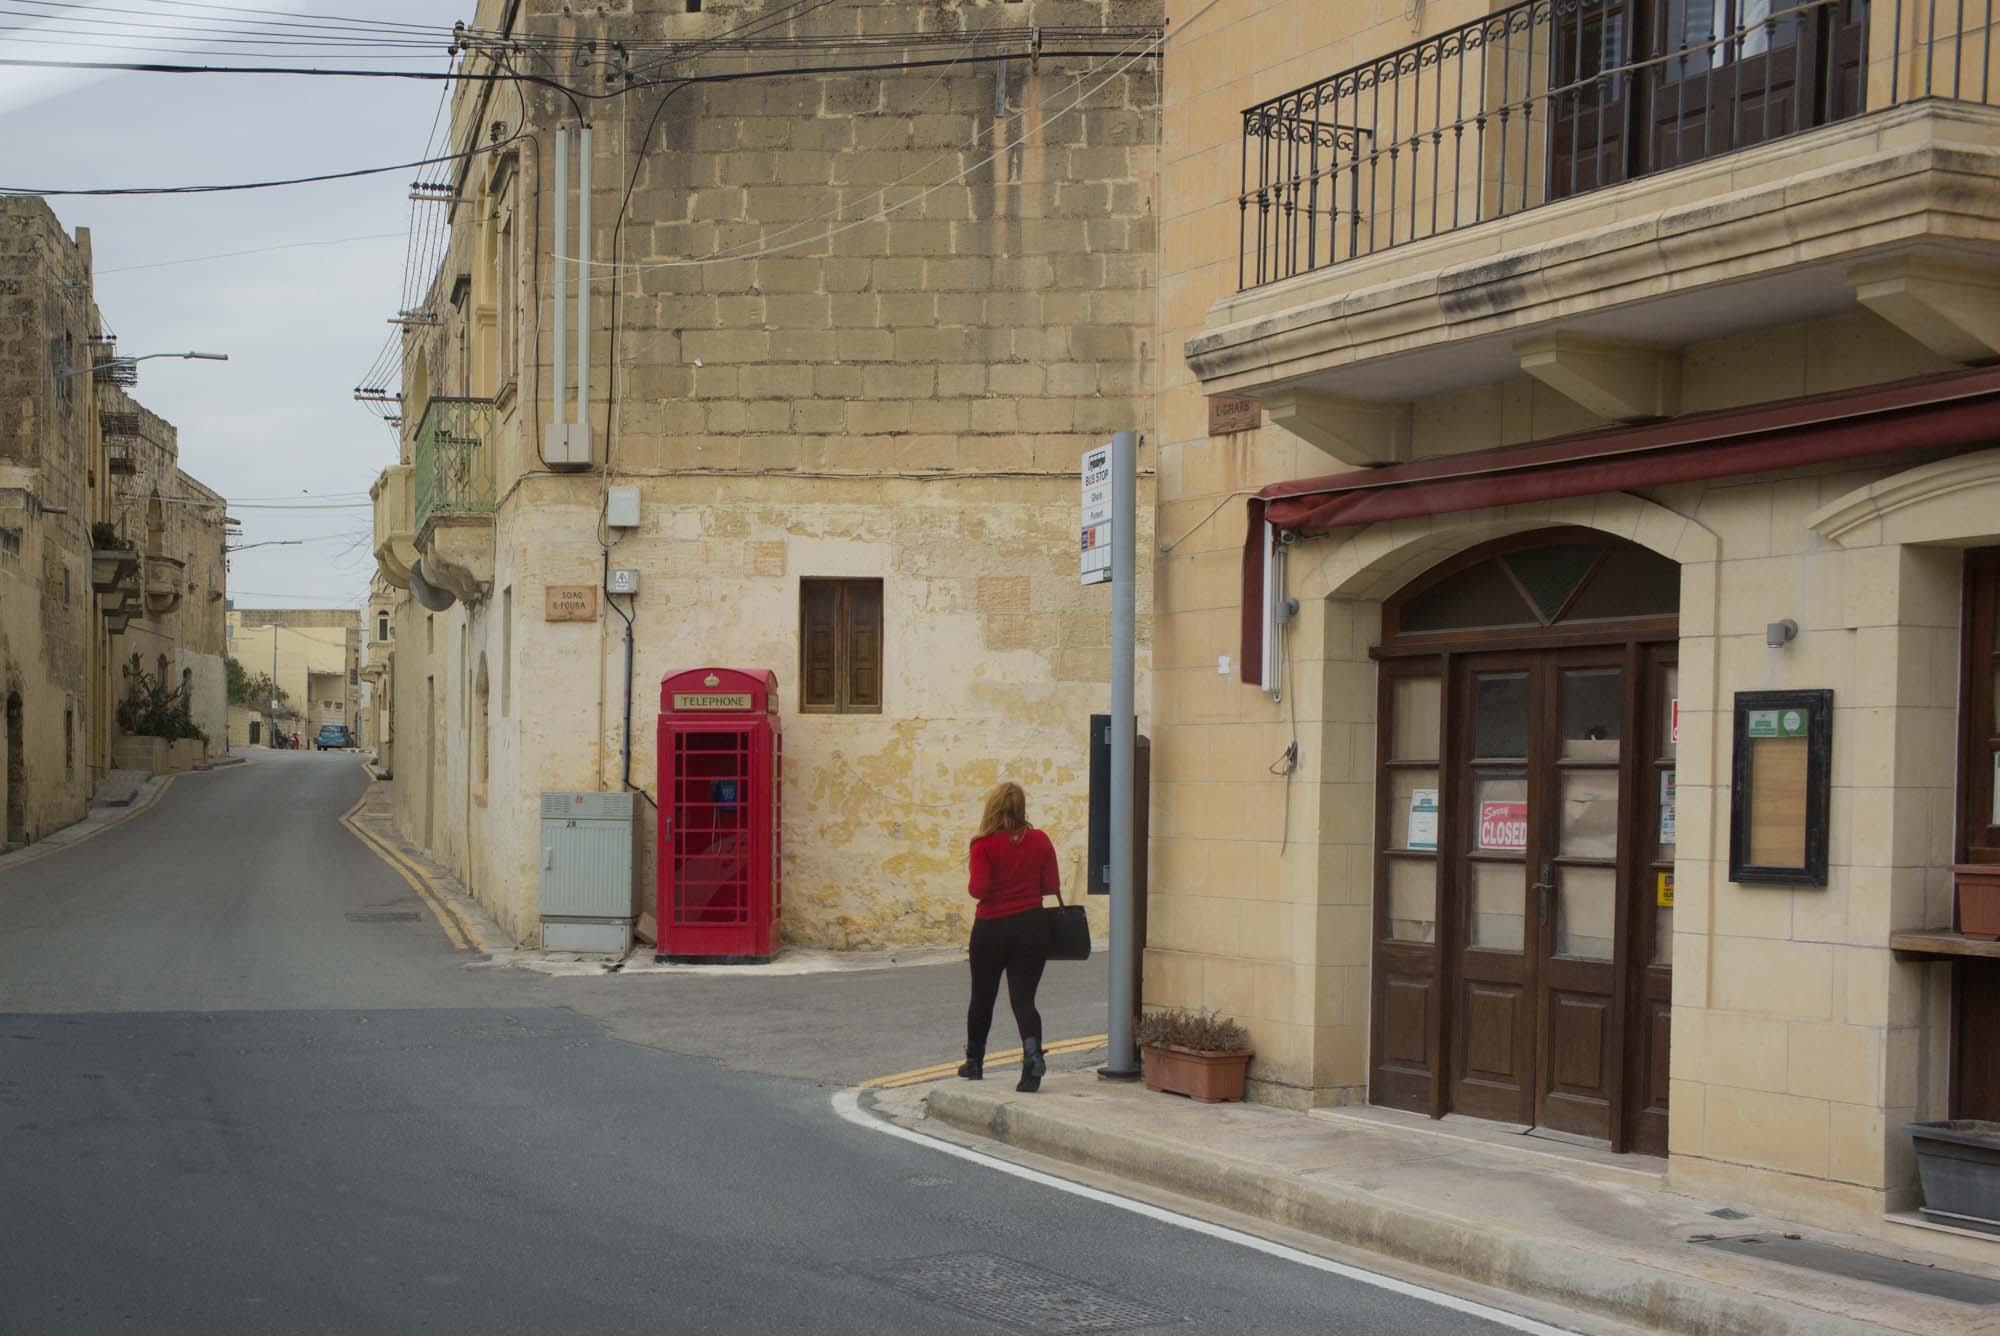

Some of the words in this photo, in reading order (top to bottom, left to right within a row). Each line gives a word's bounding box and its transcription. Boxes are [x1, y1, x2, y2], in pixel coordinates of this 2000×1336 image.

[1085, 473, 1096, 487] BUS
[1096, 469, 1109, 483] STOP
[681, 696, 744, 706] TELEPHONE
[1482, 821, 1527, 845] CLOSED
